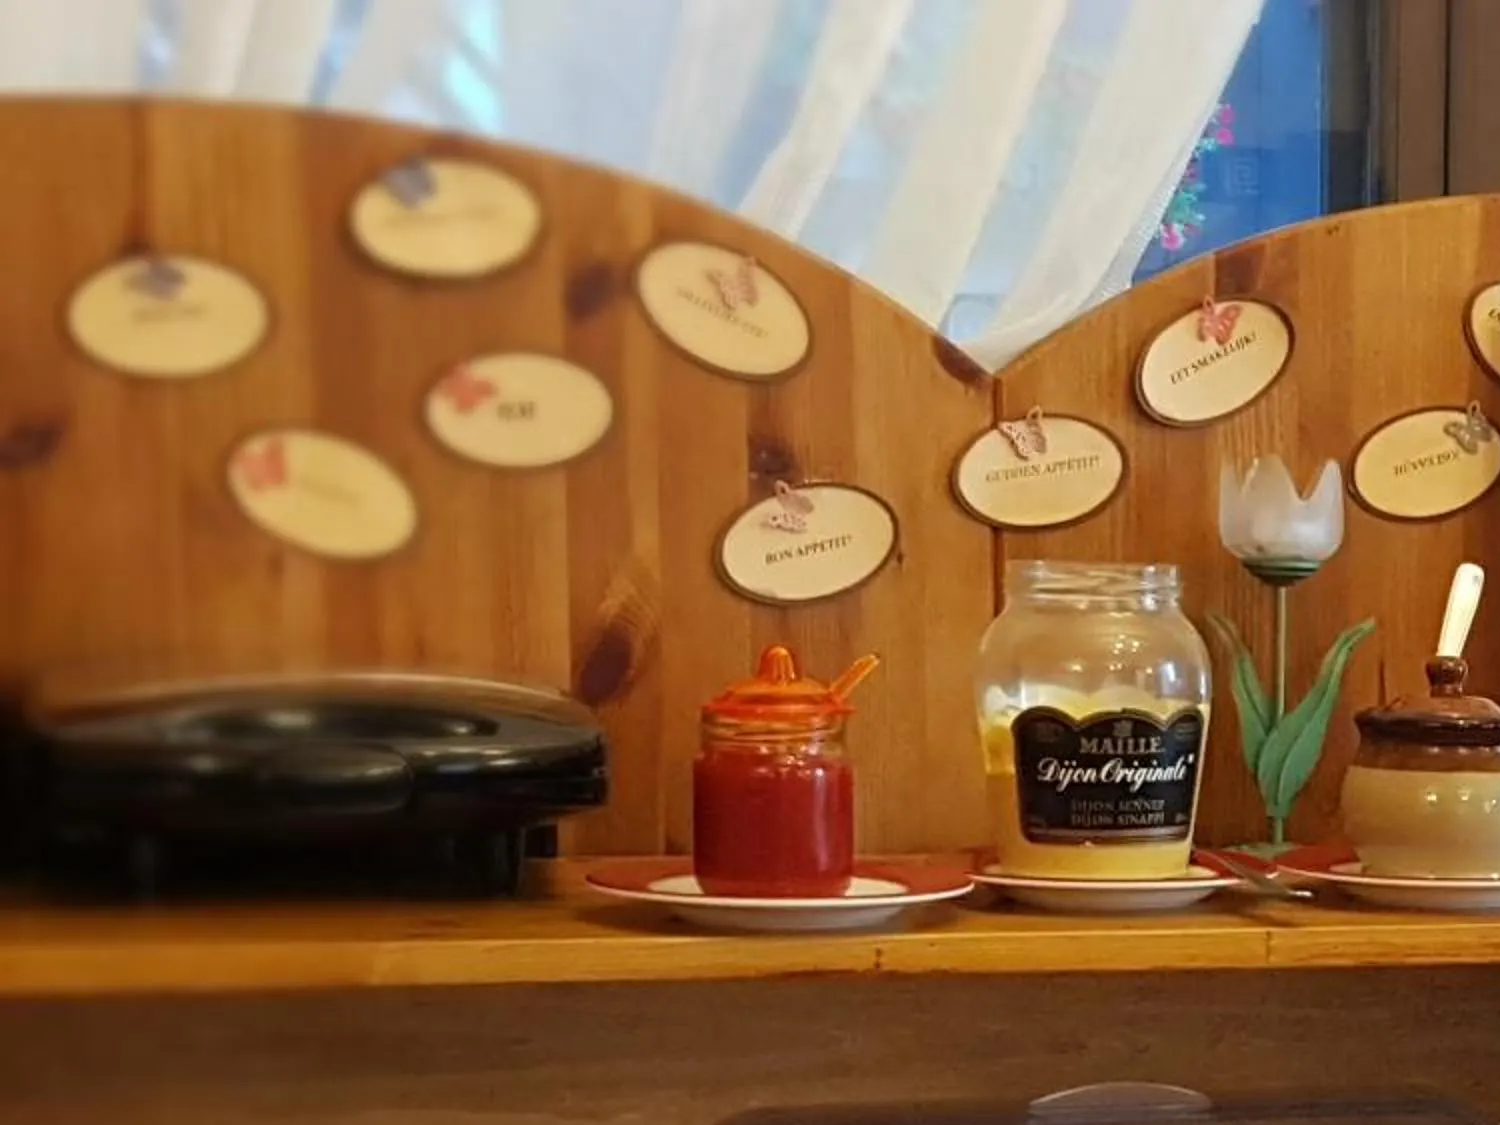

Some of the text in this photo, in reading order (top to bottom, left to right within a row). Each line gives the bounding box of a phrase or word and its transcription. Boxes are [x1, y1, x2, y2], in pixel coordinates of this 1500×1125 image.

[765, 549, 793, 565] BON
[1079, 736, 1166, 754] MAILLE
[1036, 757, 1097, 792] Dijon
